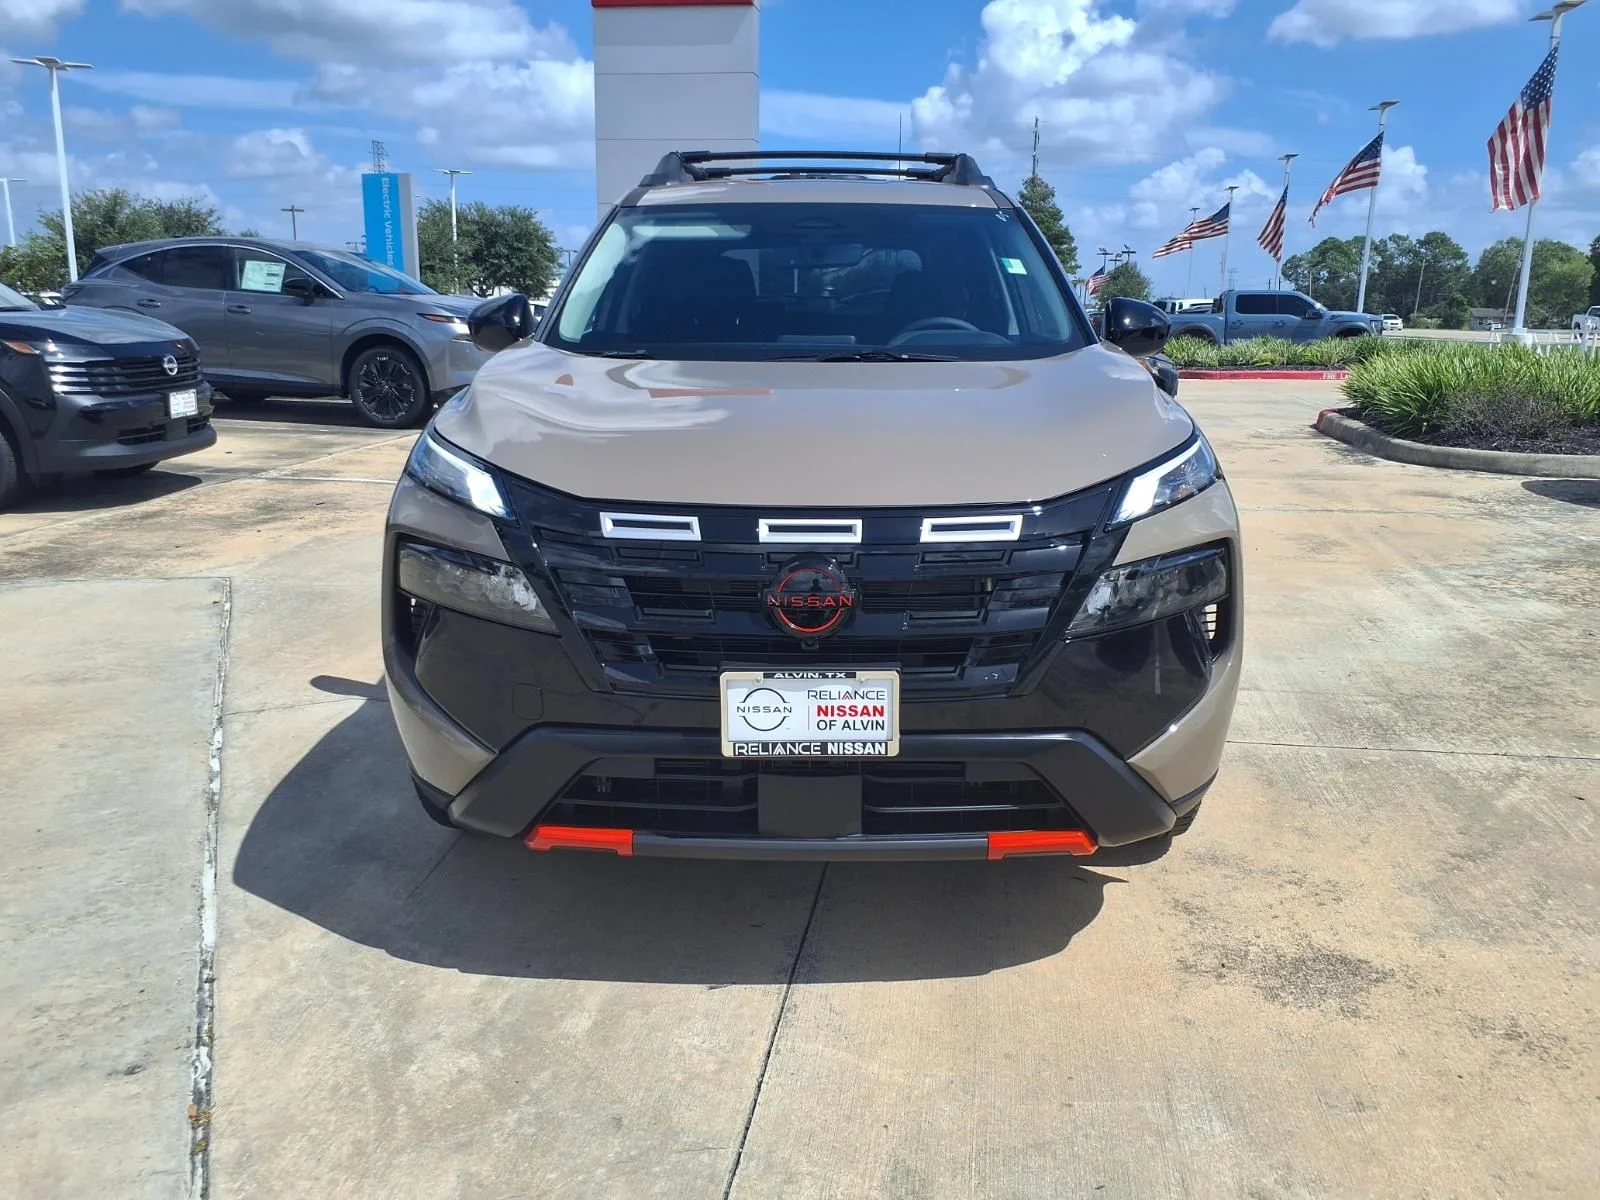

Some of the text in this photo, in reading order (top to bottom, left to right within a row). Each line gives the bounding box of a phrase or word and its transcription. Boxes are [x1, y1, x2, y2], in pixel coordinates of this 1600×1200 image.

[382, 178, 394, 265] Electric Vehicles
[767, 595, 853, 607] NISSAN
[807, 690, 885, 700] RELIANCE
[817, 705, 885, 717] NISSAN
[816, 720, 885, 730] OF ALVIN
[735, 743, 886, 755] RELIANCE NISSAN
